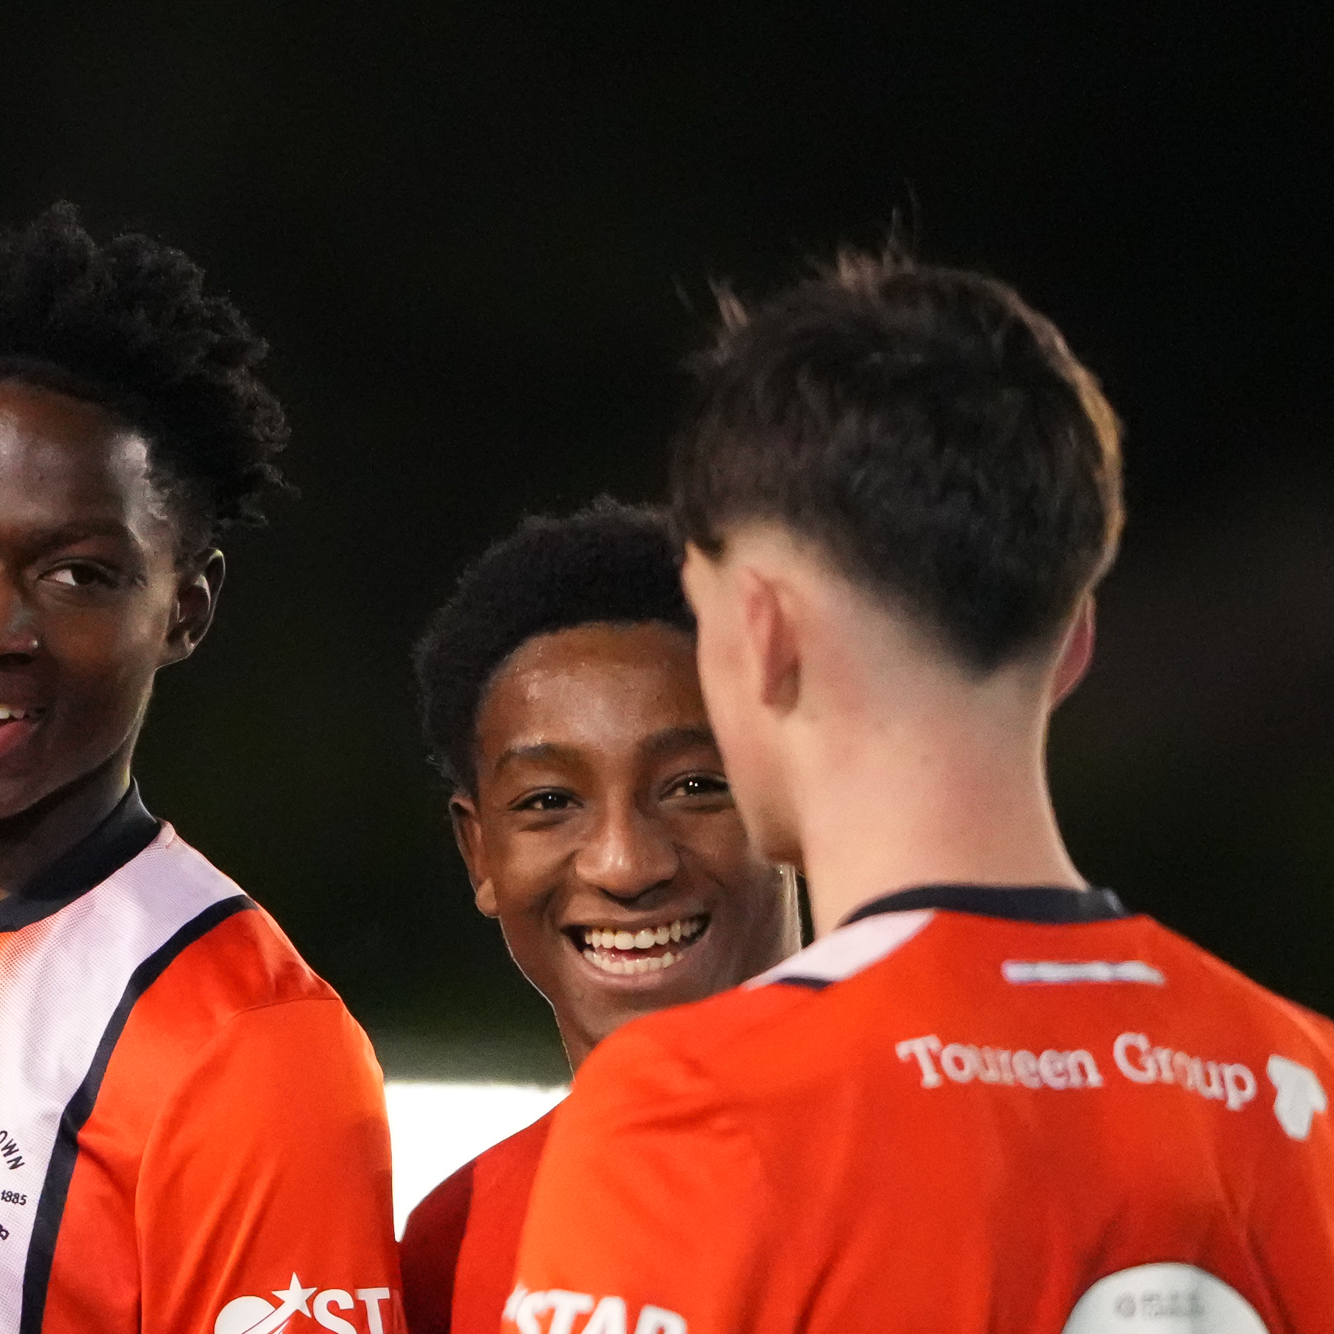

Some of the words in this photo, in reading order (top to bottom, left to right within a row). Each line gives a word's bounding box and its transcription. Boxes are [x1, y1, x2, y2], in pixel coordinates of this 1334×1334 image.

[896, 1034, 1103, 1089] Toureen
[1113, 1032, 1257, 1110] Group
[1, 1189, 28, 1206] 1885
